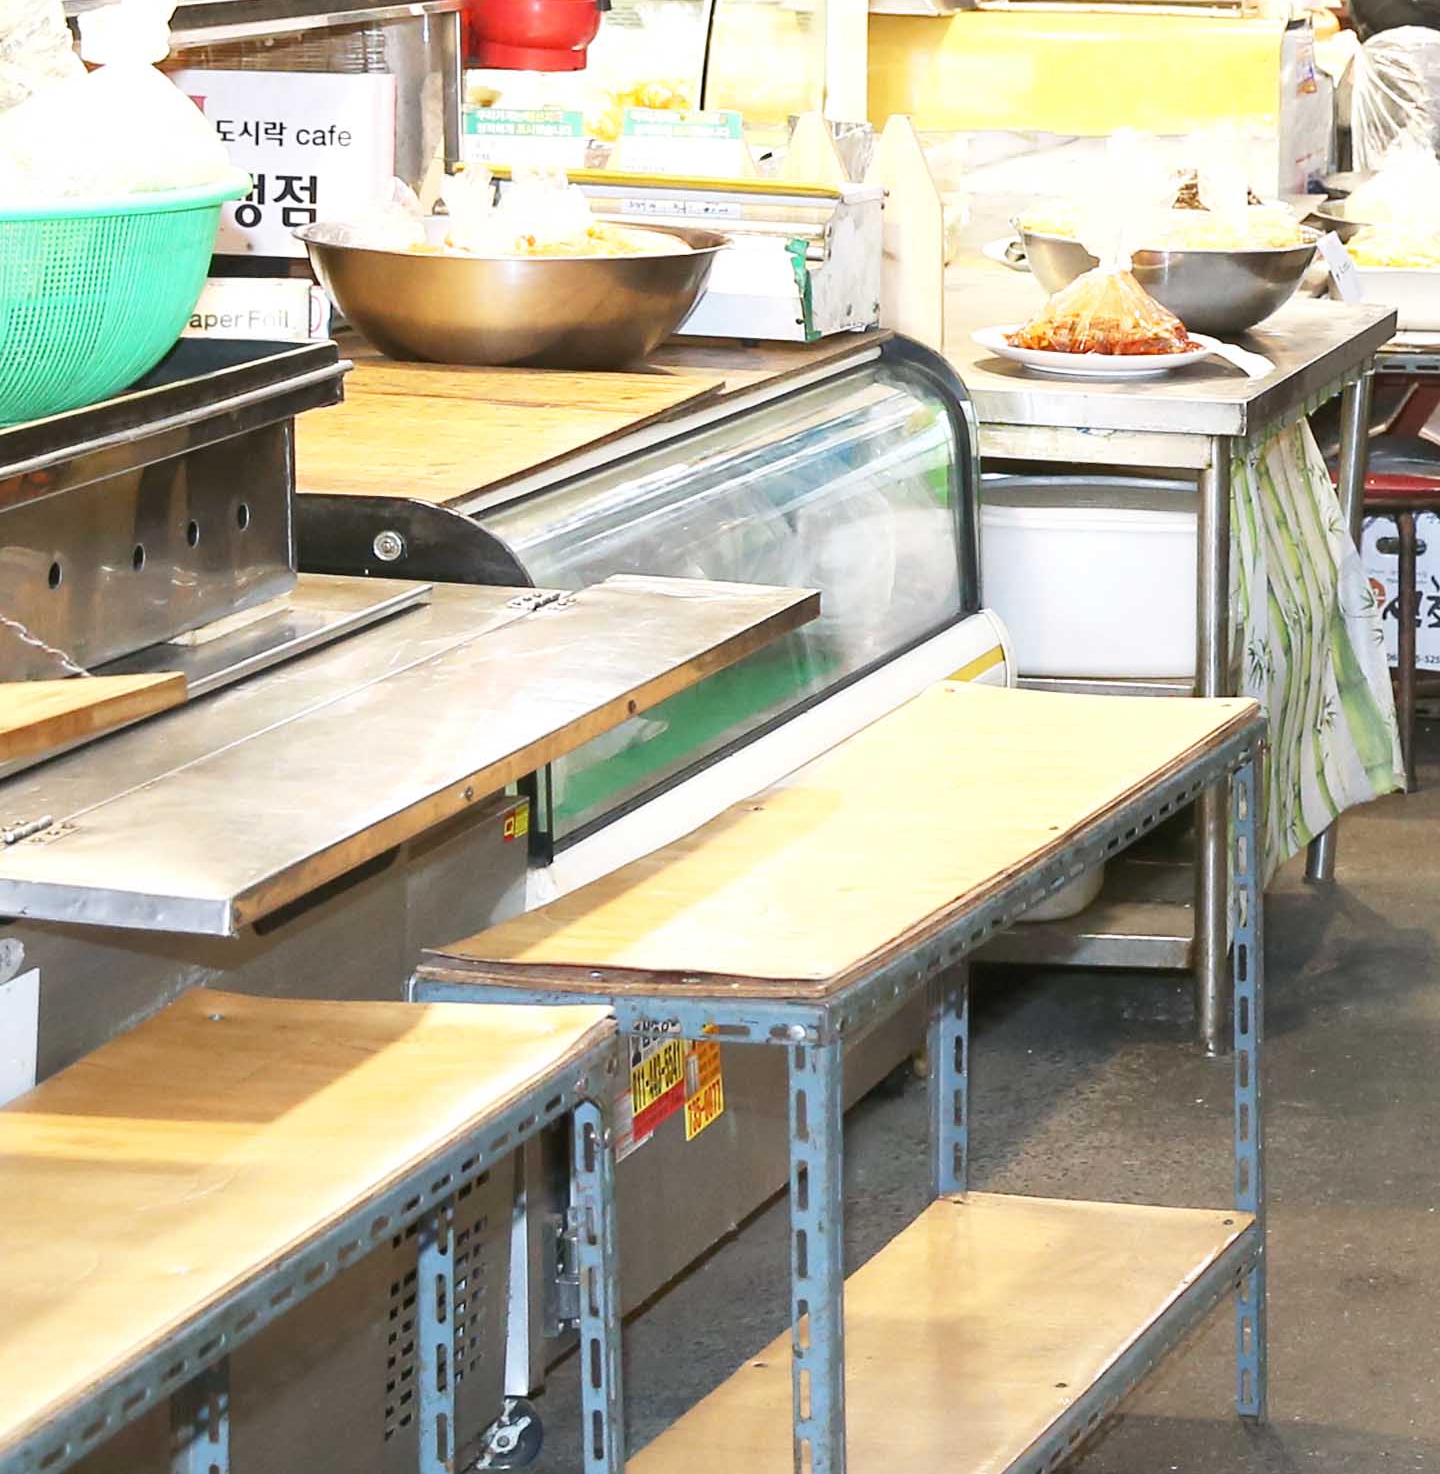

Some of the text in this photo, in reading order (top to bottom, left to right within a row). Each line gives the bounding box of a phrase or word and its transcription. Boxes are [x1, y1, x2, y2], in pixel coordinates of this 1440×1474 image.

[216, 120, 352, 147] 도시락 cafe
[189, 311, 244, 329] aper
